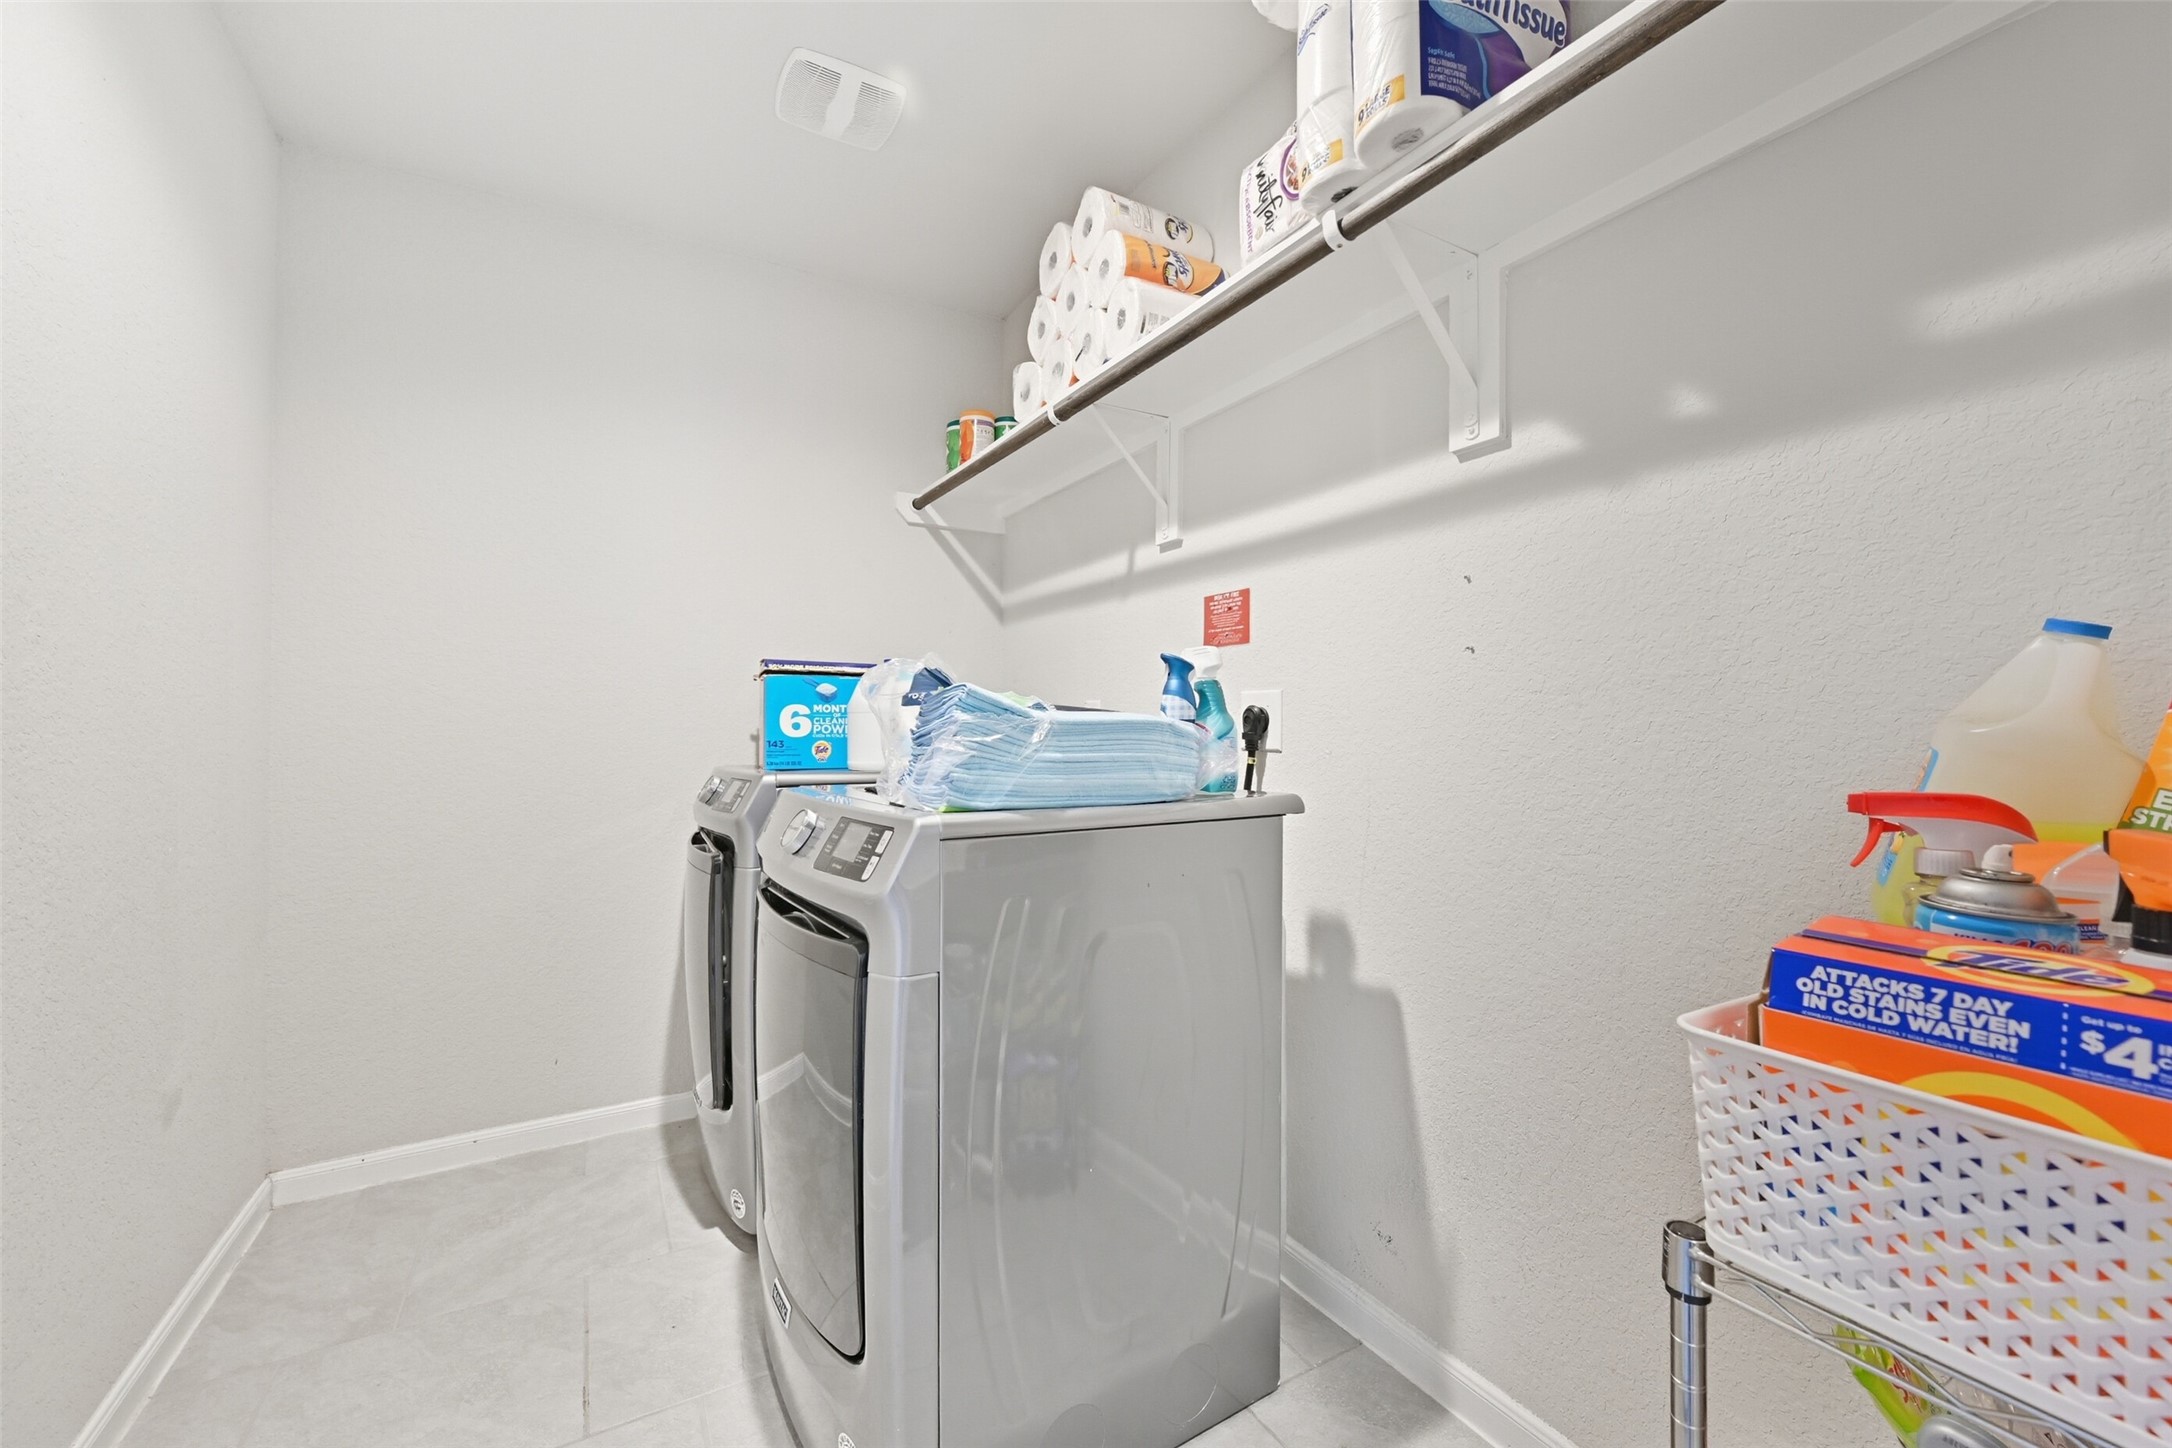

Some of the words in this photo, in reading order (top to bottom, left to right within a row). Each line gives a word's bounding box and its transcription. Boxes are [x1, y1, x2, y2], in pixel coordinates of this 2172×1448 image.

[1358, 109, 1365, 126] 9
[779, 704, 812, 738] 6
[766, 740, 785, 748] 143
[1935, 950, 2130, 985] Tide
[1795, 976, 1844, 999] OLD
[1848, 988, 1943, 1020] STAINS
[1949, 1006, 2031, 1040] EVEN
[1809, 965, 1925, 1000] ATTACKS
[1929, 987, 1948, 1004] 7
[1953, 992, 2014, 1018] DAY
[1802, 992, 1827, 1012] IN
[1832, 999, 1901, 1026] COLD
[1906, 1016, 2018, 1054] WATER!
[2080, 1015, 2104, 1027] Get
[2106, 1021, 2125, 1031] up
[2126, 1024, 2143, 1034] to
[2079, 1030, 2159, 1081] $4
